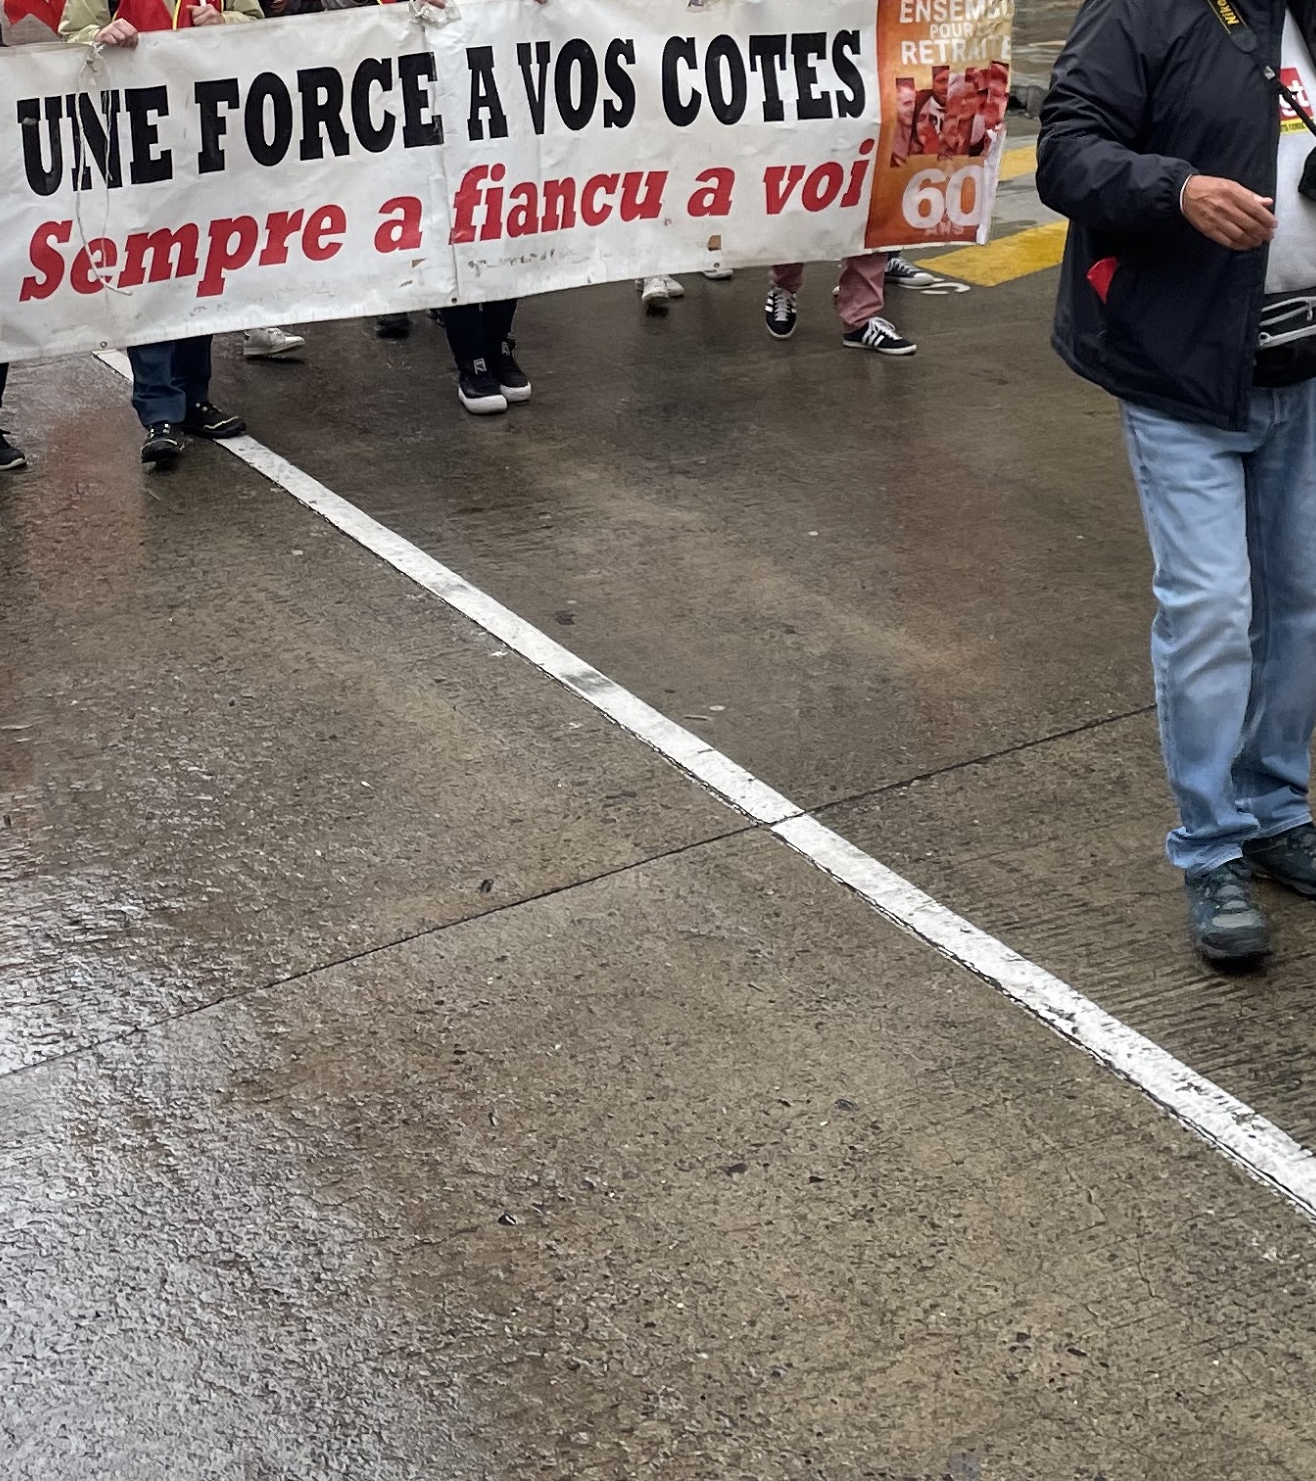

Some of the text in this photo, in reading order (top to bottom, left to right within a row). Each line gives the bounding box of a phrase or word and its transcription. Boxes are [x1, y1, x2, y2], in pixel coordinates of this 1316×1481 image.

[930, 22, 973, 39] POUR
[17, 29, 866, 196] UNE FORCE A VOS COTES
[19, 138, 876, 303] Sempre a fiancu a voi
[901, 164, 983, 229] 60
